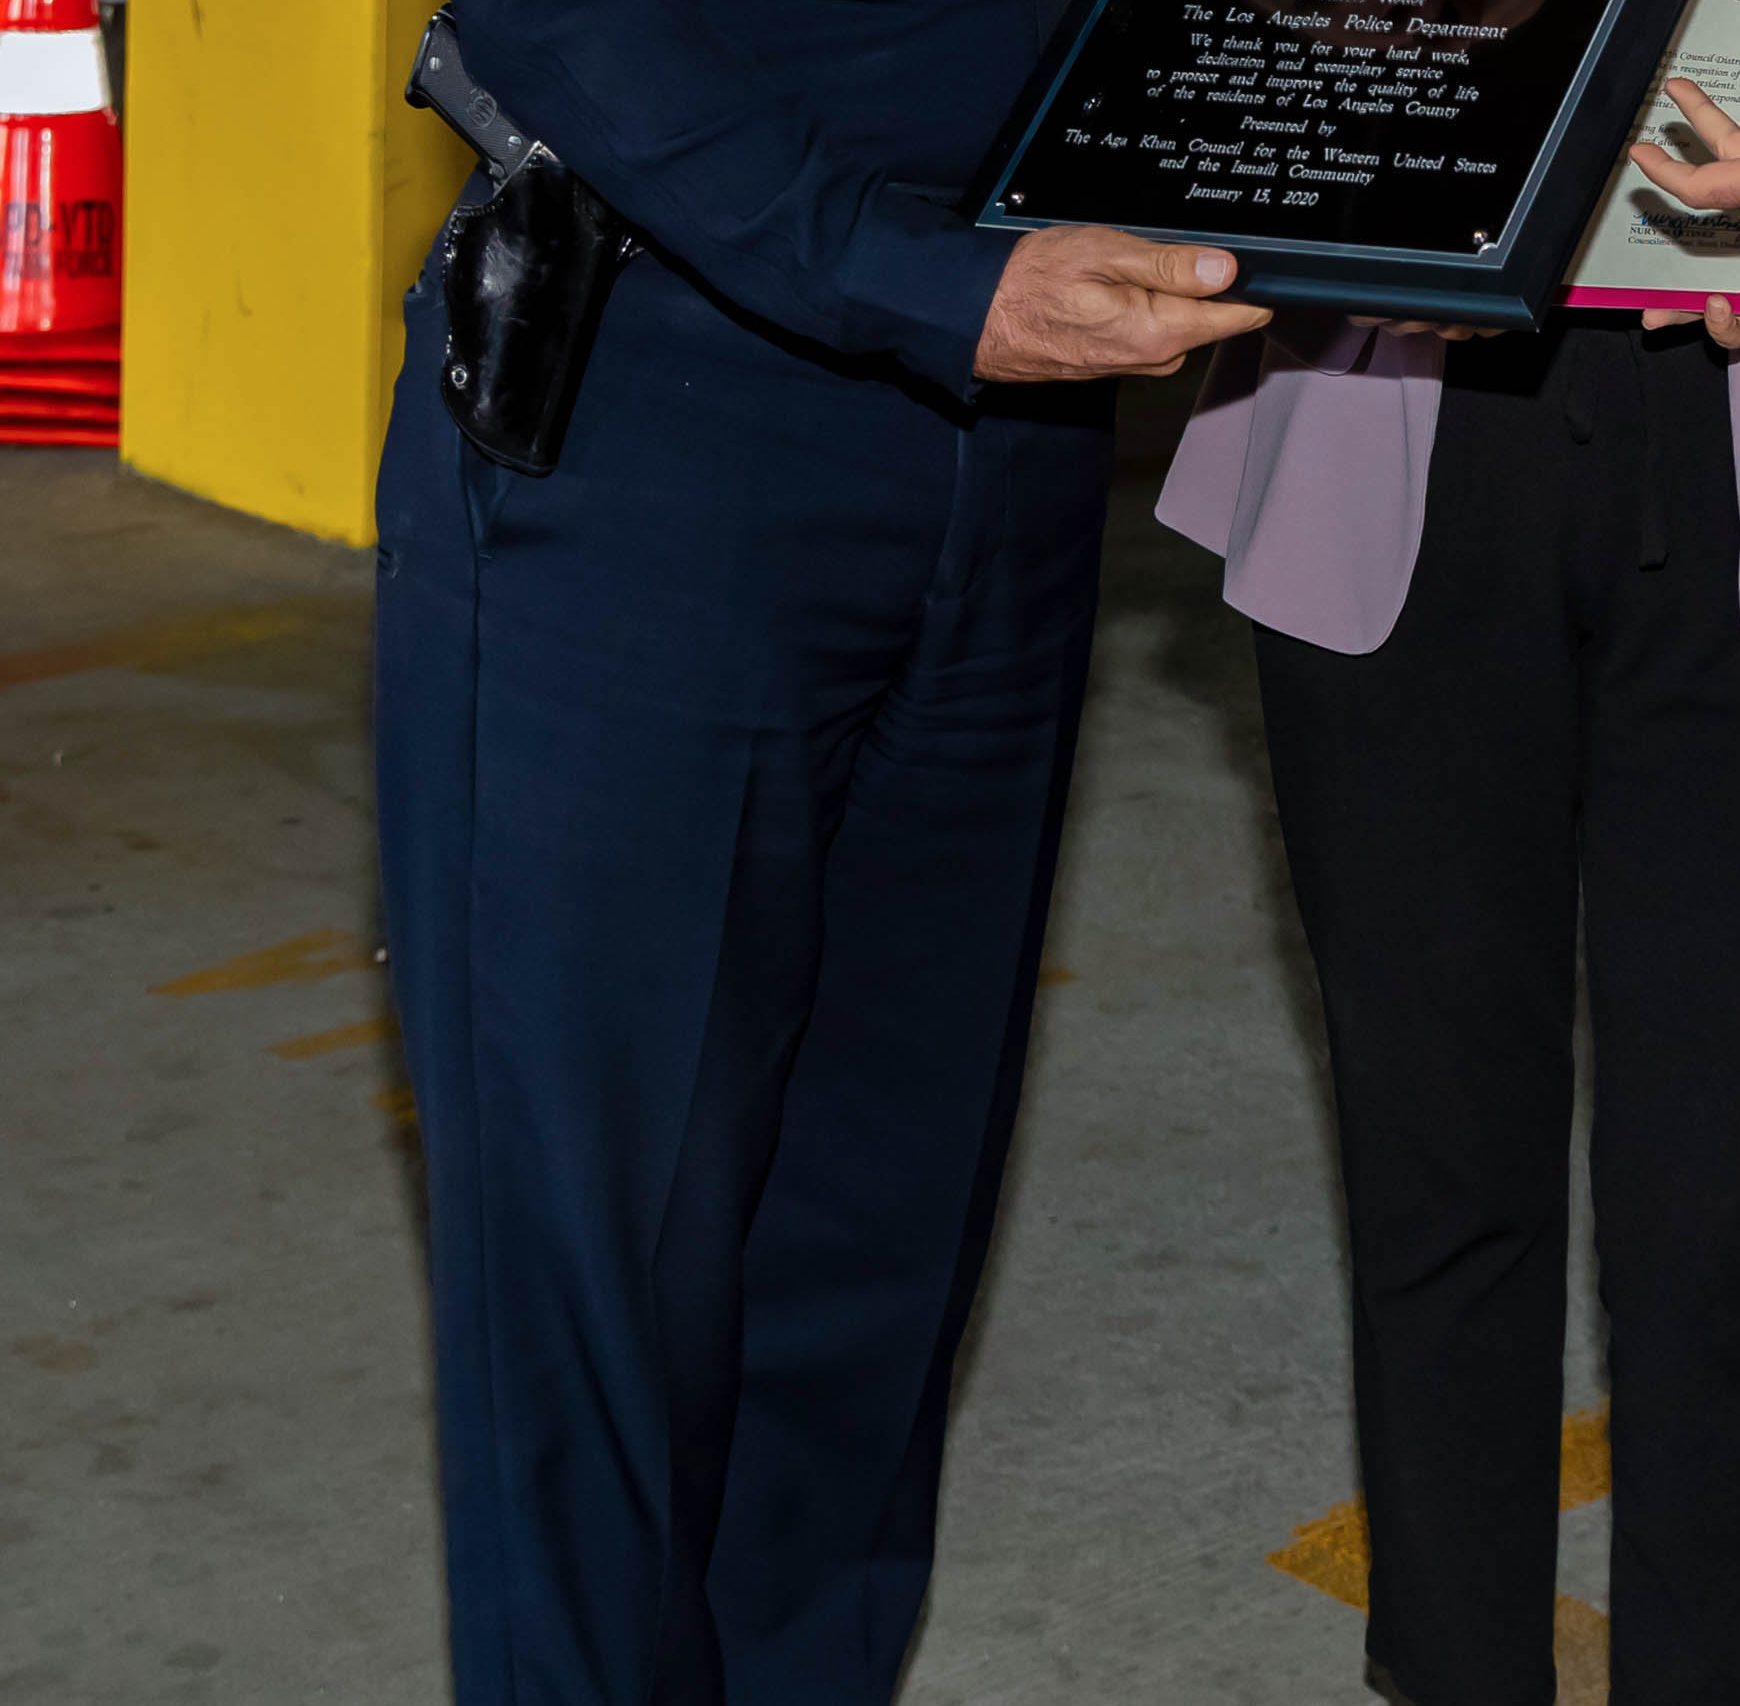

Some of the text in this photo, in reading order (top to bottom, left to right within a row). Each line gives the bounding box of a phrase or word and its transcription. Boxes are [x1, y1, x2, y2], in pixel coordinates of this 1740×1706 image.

[1182, 4, 1508, 41] The Los Angeles Police Department
[1190, 32, 1213, 47] We
[1223, 35, 1264, 51] thank
[1273, 41, 1299, 55] you
[1310, 40, 1333, 55] for
[1344, 45, 1376, 59] your
[1386, 45, 1420, 61] hard
[1680, 52, 1714, 63] Council
[1196, 51, 1444, 79] dedication and exemplary service
[1680, 65, 1728, 77] recognition
[1146, 67, 1480, 102] to protect and improve the quality of life
[1146, 83, 1460, 119] of the residents of Los Angeles County
[1239, 115, 1337, 137] Presented by
[1065, 128, 1497, 174] The Aga Khan Council for the Western United States
[1159, 155, 1375, 185] and the Ismaili Community
[1185, 182, 1319, 206] January 15, 2020
